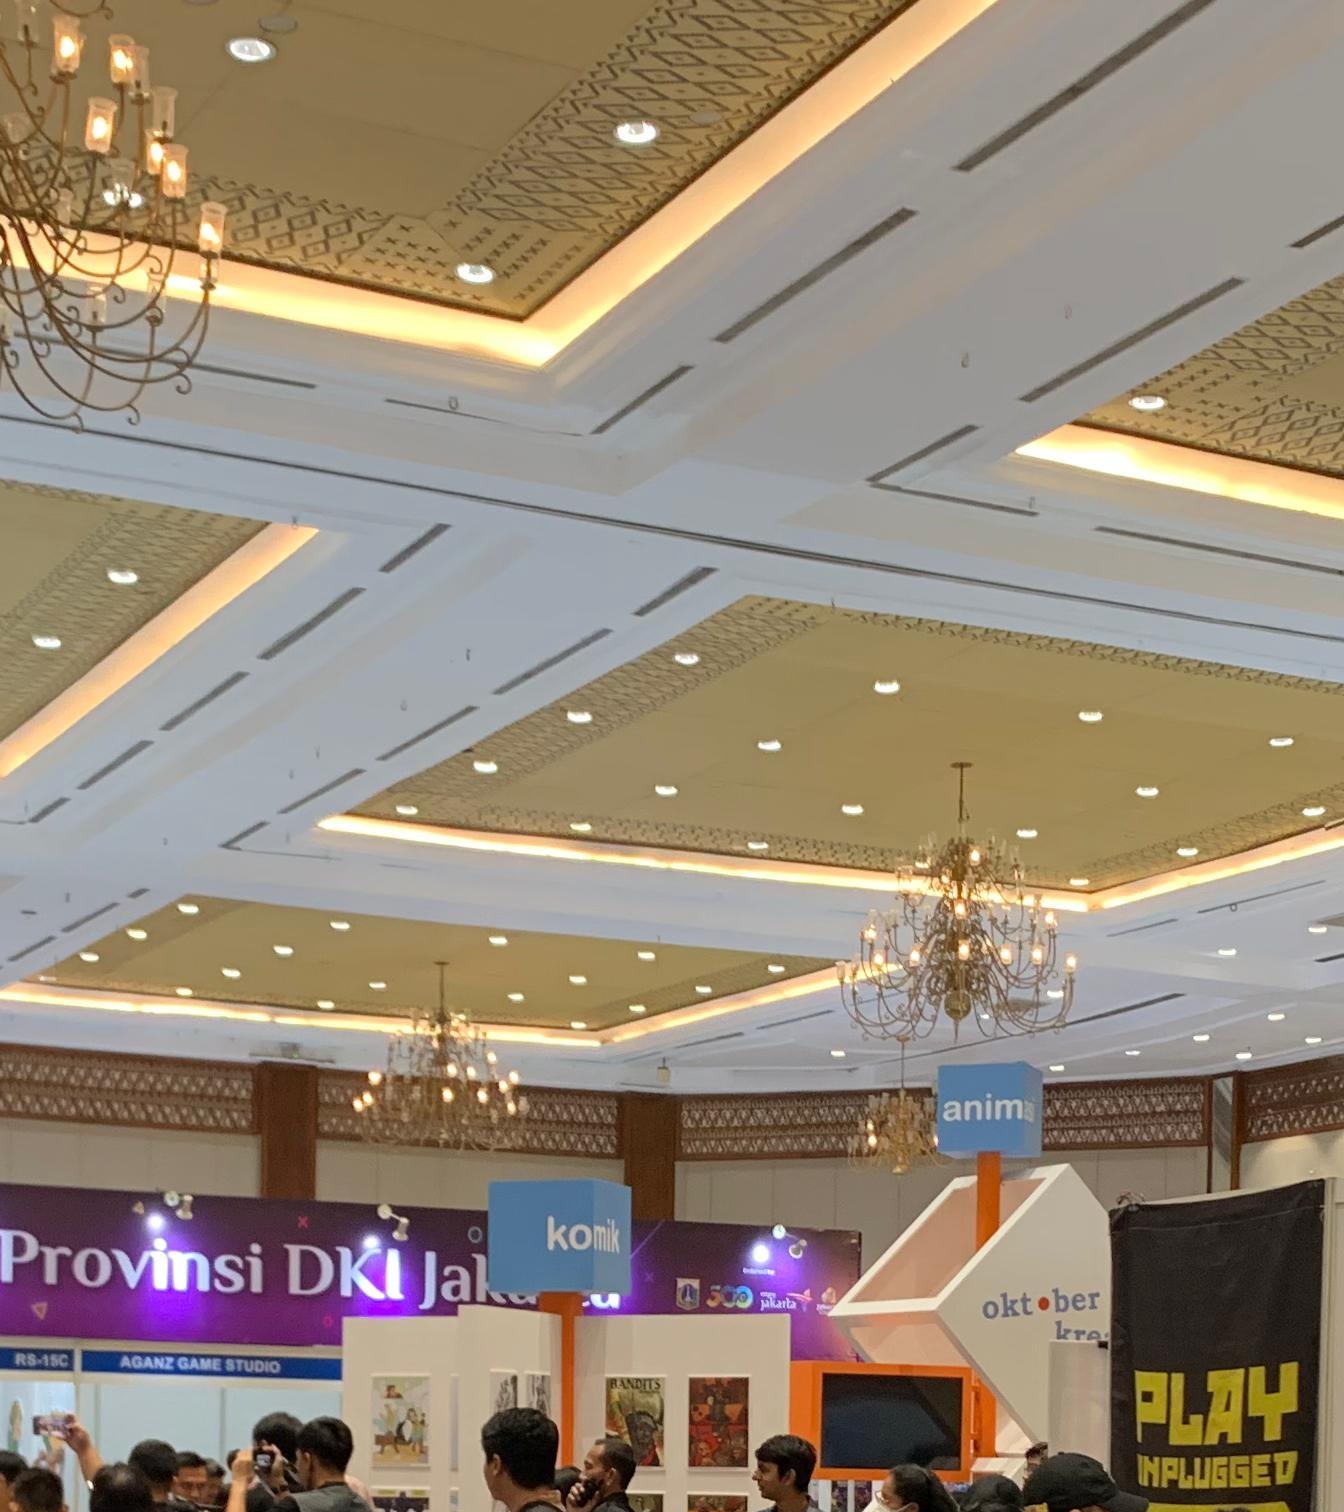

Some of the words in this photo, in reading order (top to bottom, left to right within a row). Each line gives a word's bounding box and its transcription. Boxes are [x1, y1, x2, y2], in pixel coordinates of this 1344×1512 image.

[547, 1215, 620, 1254] komik
[284, 1243, 405, 1300] DKI
[1055, 1320, 1109, 1340] kre
[120, 1354, 174, 1370] AGANZ
[177, 1356, 222, 1372] GAME
[224, 1357, 281, 1374] STUDIO
[610, 1378, 661, 1390] BANDITS
[1134, 1361, 1299, 1446] PLAY
